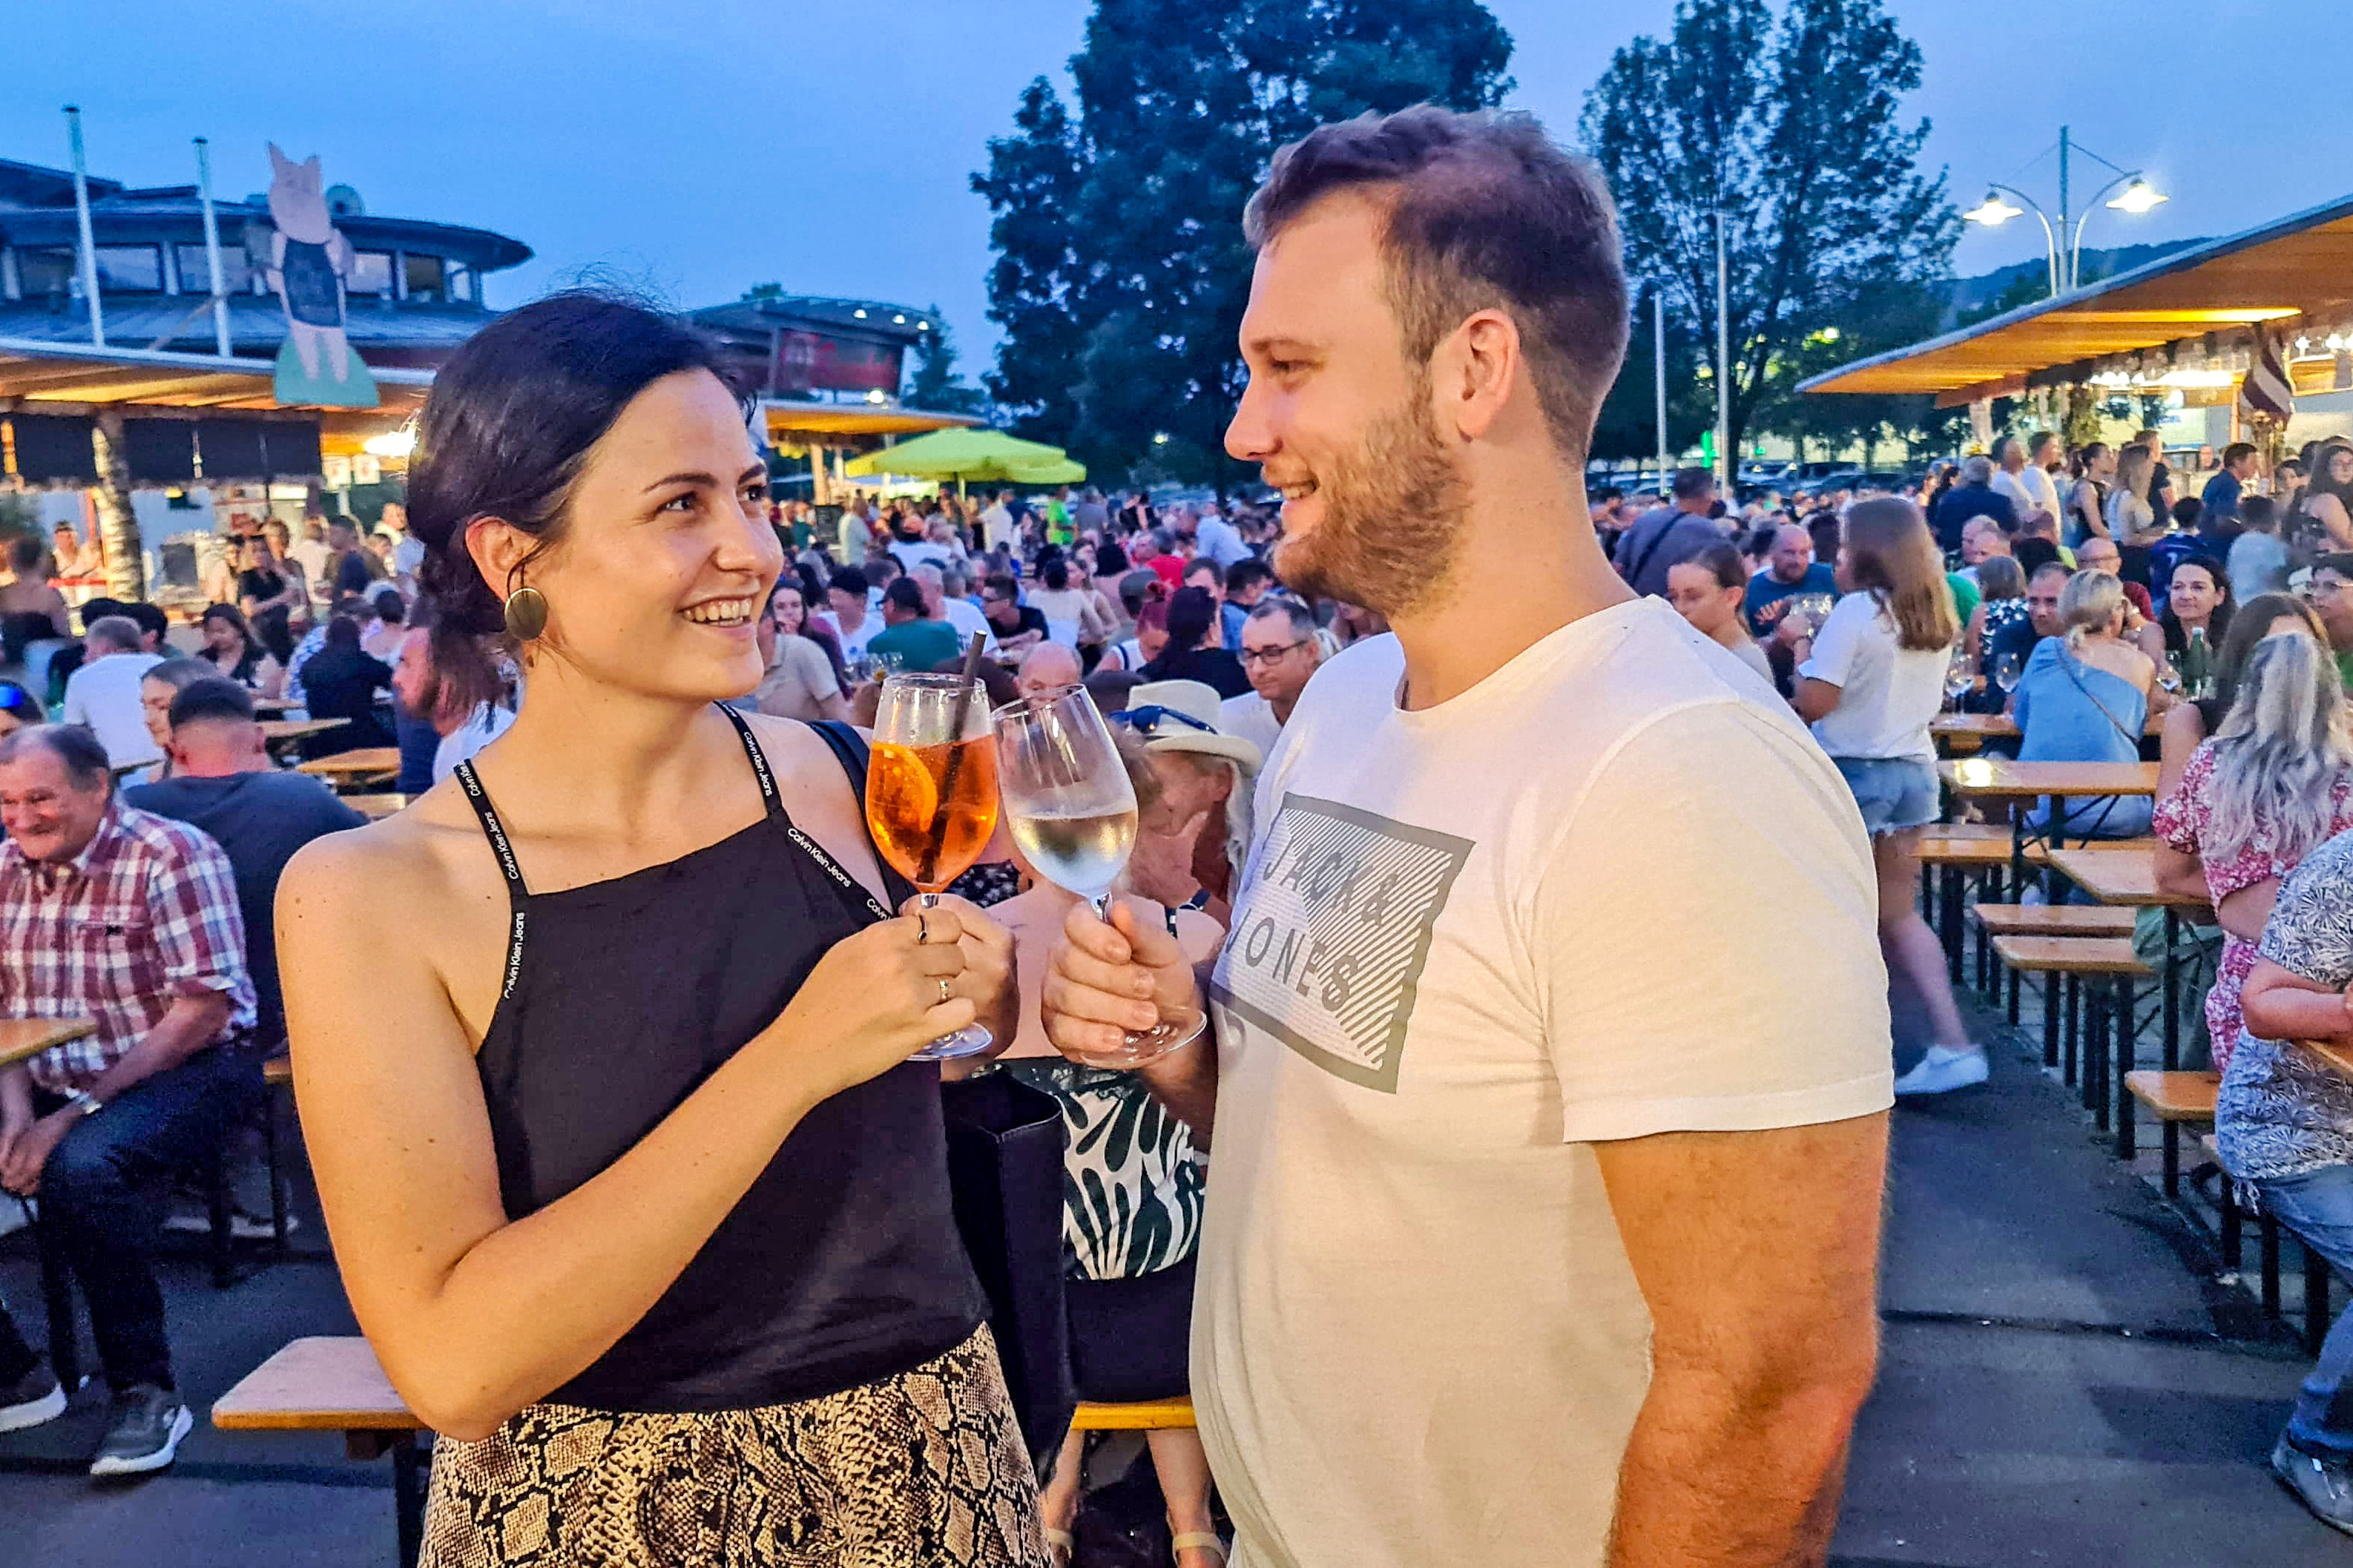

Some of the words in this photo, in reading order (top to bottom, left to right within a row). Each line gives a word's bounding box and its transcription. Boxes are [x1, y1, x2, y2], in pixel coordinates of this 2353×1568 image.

[759, 772, 773, 797] Jeans
[484, 811, 500, 834] Jeans
[495, 834, 510, 853] Klein
[503, 852, 519, 880] Calvin
[788, 828, 812, 852] Calvin
[809, 847, 829, 869] Klein
[827, 865, 852, 887] Jeans
[1263, 836, 1372, 914] JACK
[1360, 870, 1398, 926] &
[866, 898, 888, 921] Calvin
[514, 912, 525, 942] Jeans
[510, 941, 523, 966] Klein
